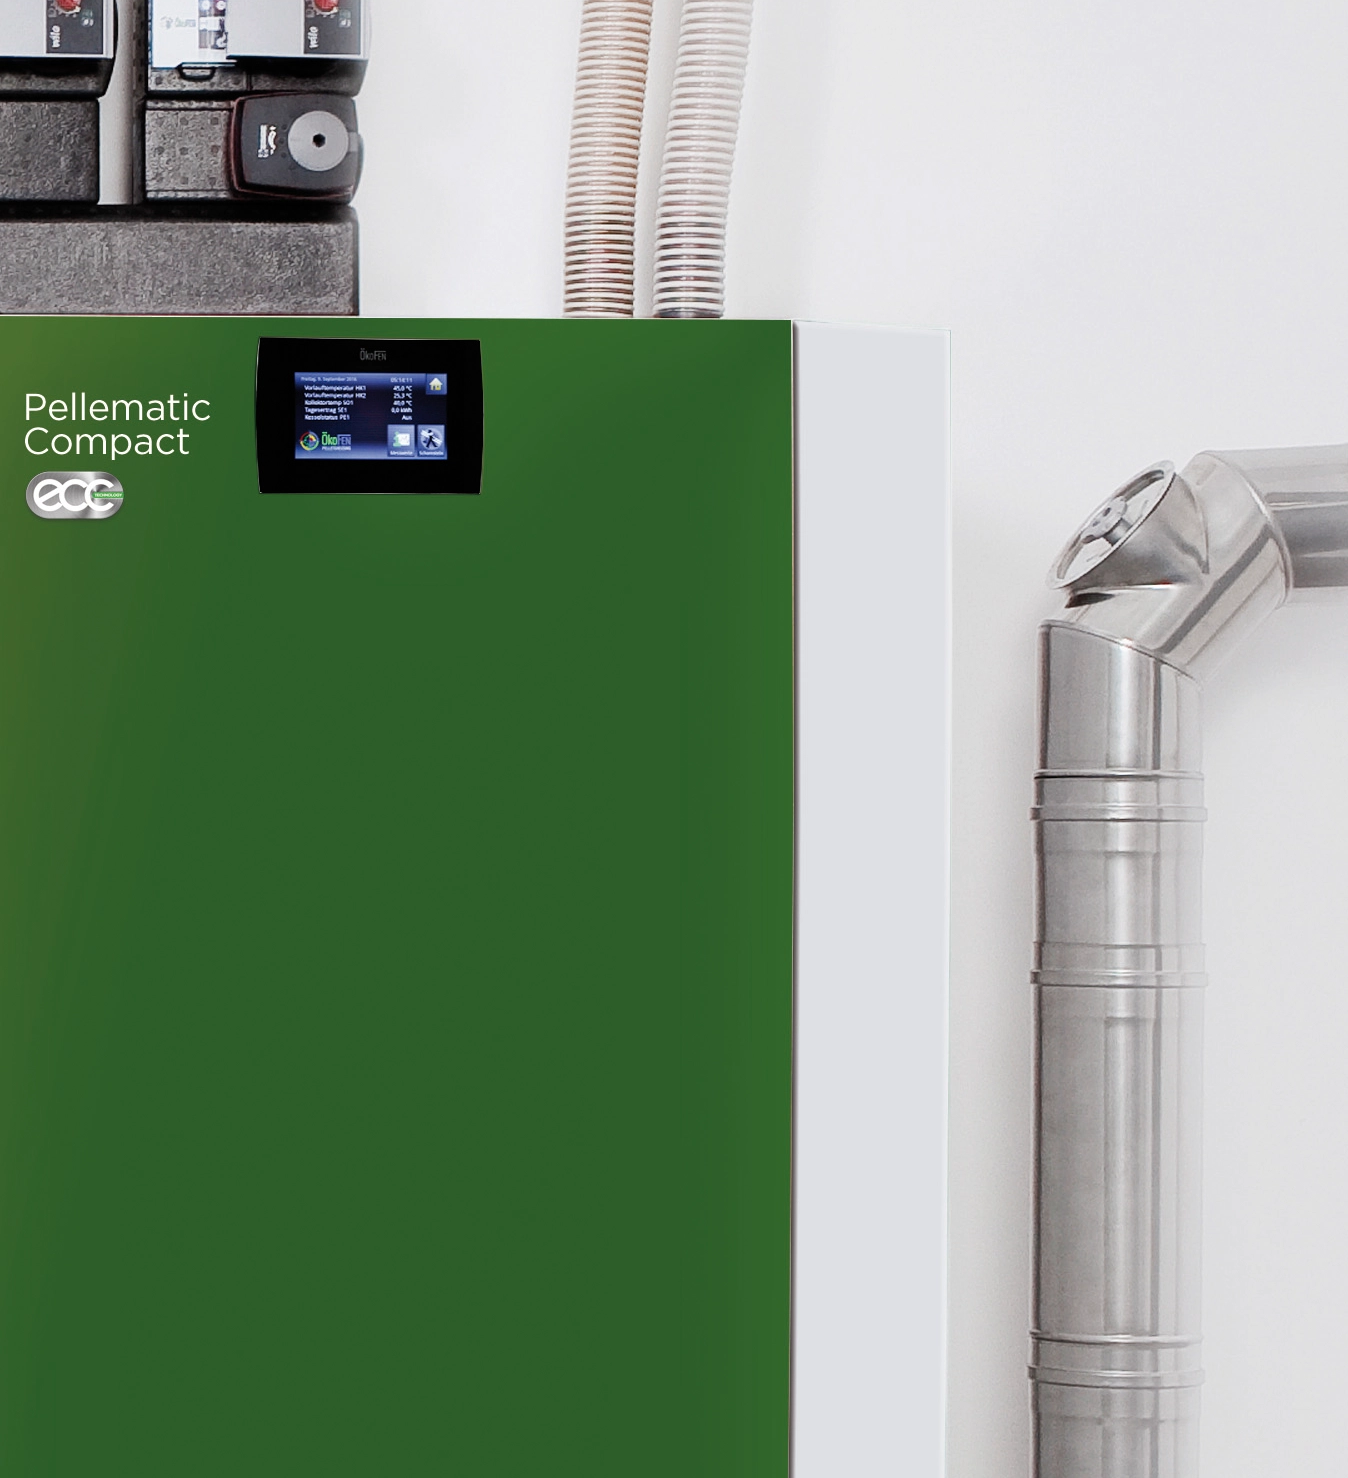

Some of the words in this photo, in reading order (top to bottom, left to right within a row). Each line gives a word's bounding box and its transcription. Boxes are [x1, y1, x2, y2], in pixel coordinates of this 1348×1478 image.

[24, 392, 211, 422] Pellematic
[24, 427, 190, 460] Compact
[321, 431, 352, 446] ÖkoFEN
